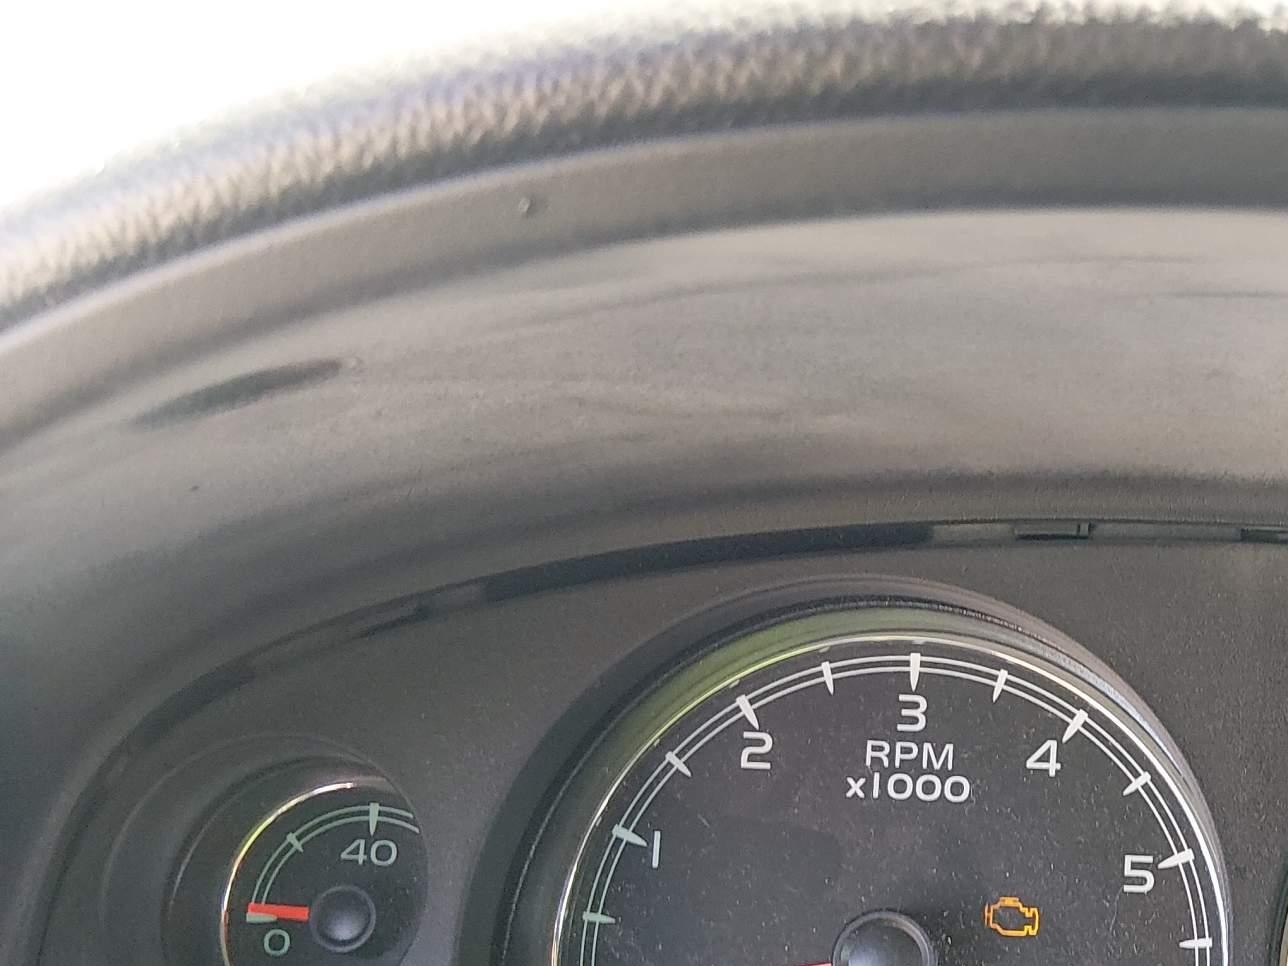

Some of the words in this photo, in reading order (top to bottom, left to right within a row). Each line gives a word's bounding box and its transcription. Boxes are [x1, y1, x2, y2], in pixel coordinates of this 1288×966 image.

[896, 694, 928, 732] 3
[740, 731, 773, 770] 2
[865, 739, 954, 771] RPM
[1025, 739, 1061, 777] 4
[846, 772, 970, 803] x1000
[340, 839, 398, 866] 40
[651, 830, 661, 868] 1
[1123, 854, 1155, 894] 5
[263, 929, 291, 956] 0
